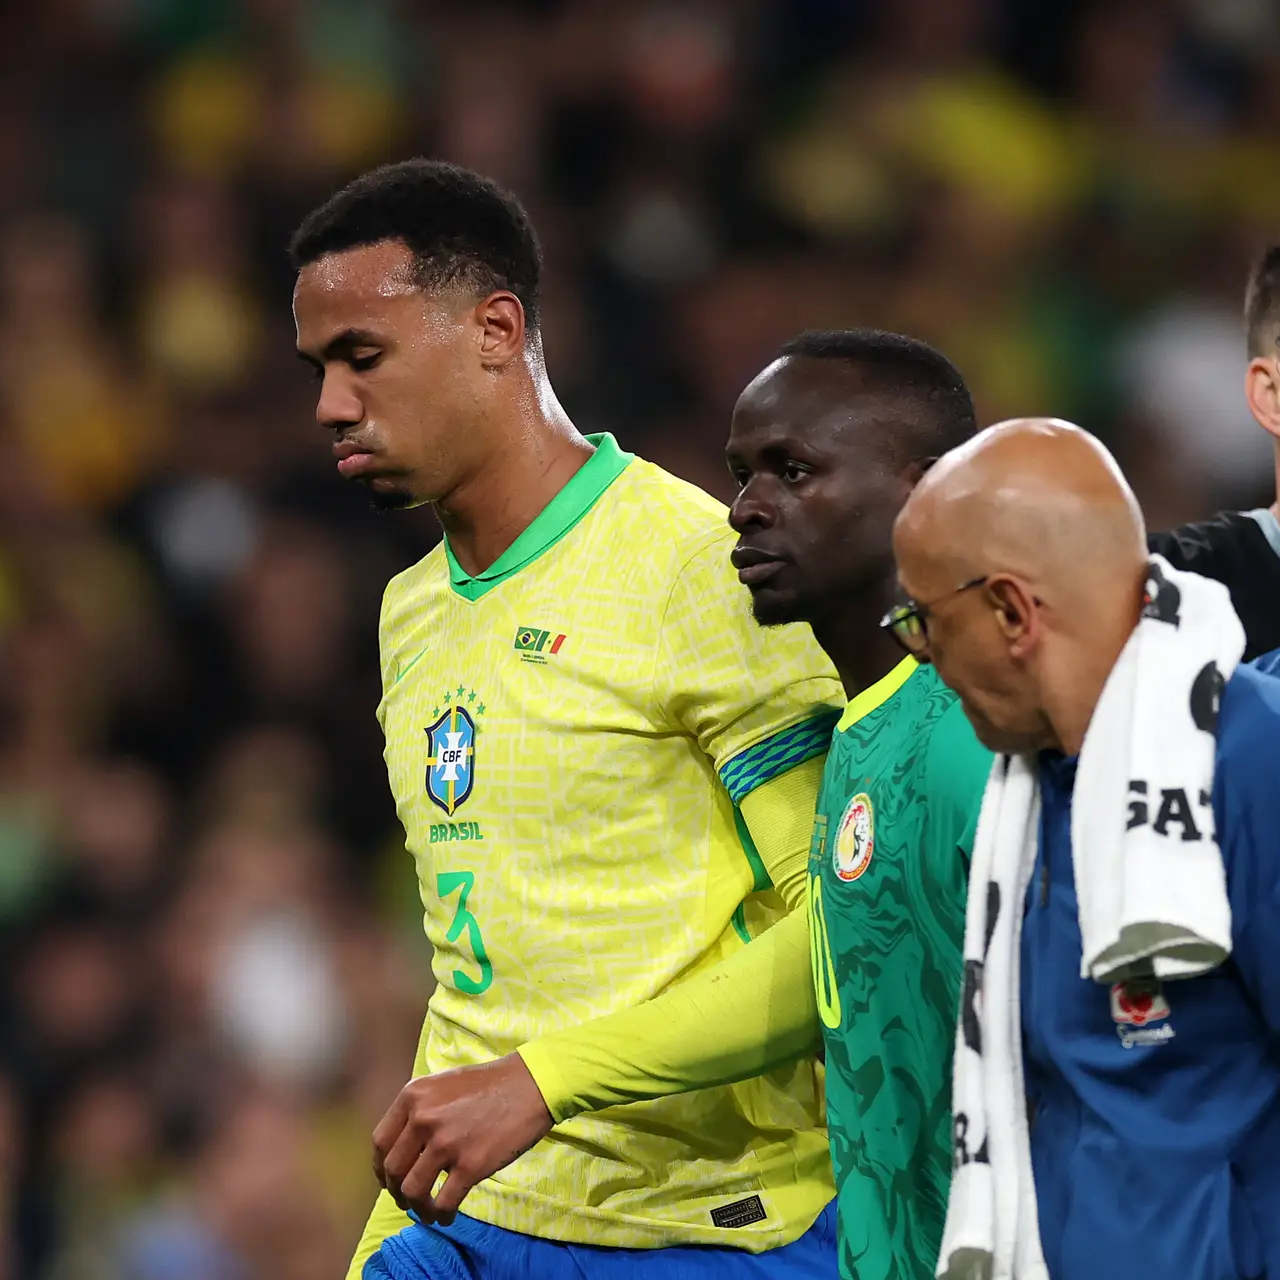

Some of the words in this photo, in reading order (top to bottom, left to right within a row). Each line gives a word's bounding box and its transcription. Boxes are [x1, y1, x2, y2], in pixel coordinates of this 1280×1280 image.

[442, 750, 462, 763] CBF
[429, 822, 484, 843] BRASIL
[436, 871, 493, 995] 3
